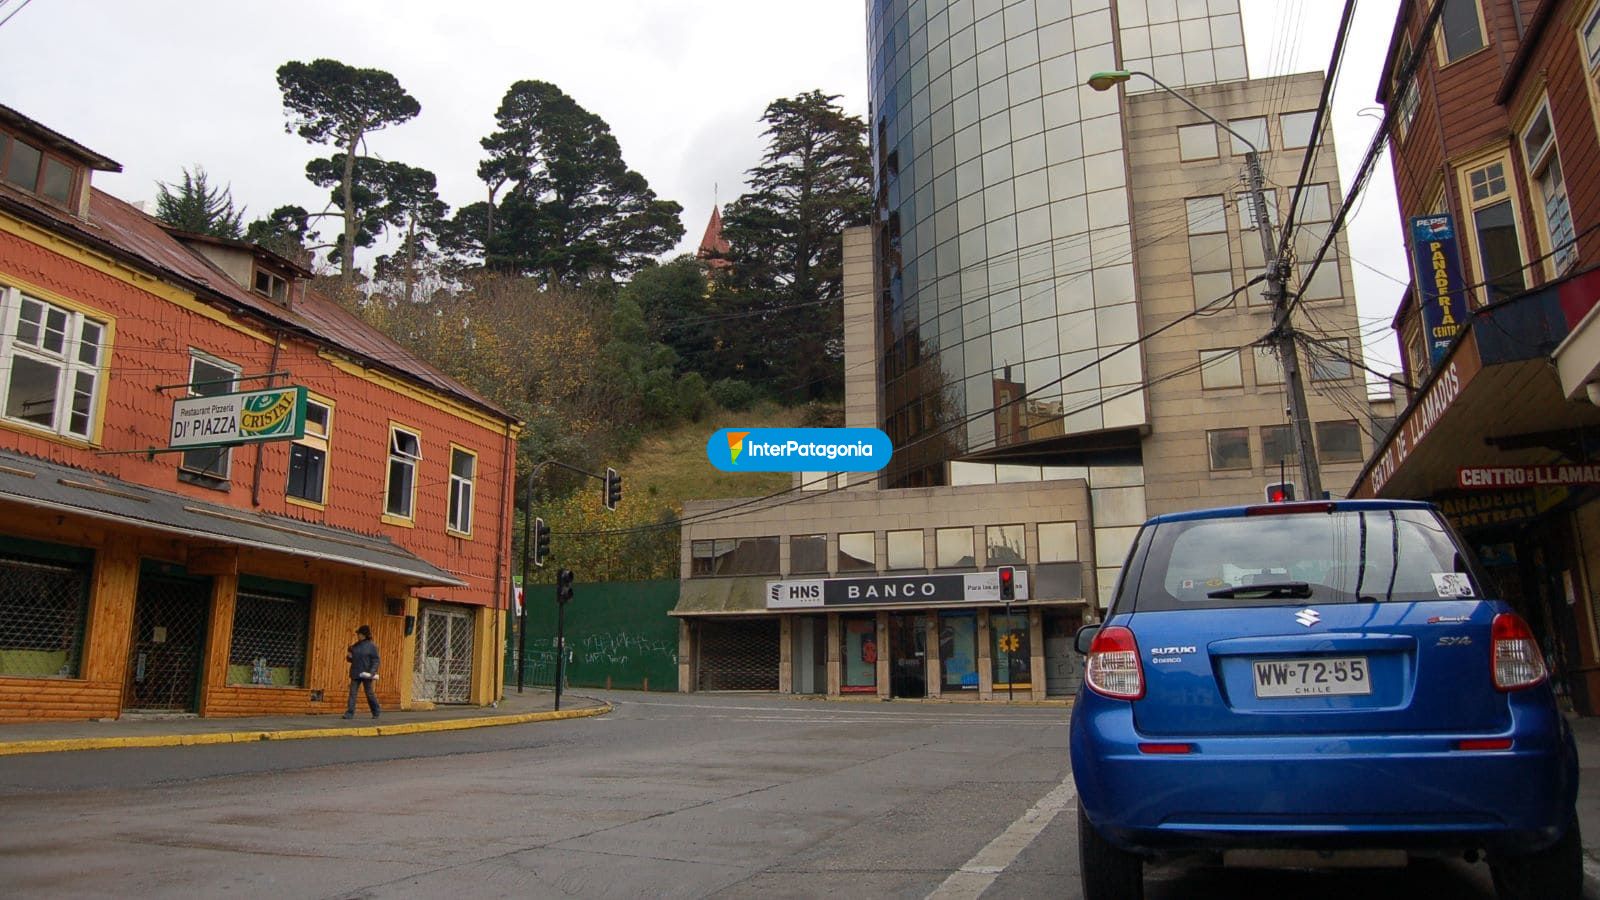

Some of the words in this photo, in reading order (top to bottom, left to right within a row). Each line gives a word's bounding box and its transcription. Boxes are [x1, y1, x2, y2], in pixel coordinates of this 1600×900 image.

[1416, 217, 1448, 227] PEPSI
[1430, 242, 1454, 325] PANADERIA
[180, 406, 210, 417] Restaurant
[211, 403, 234, 414] Pizzeria
[241, 391, 294, 428] CRISTAL
[193, 416, 236, 437] PIAZZA
[1371, 448, 1394, 494] CENTRO
[1396, 429, 1407, 463] DE
[1409, 361, 1460, 446] LLAMADOS
[1461, 468, 1525, 486] CENTRO
[790, 585, 820, 600] HNS
[848, 582, 937, 599] BANCO
[1151, 646, 1197, 655] SUZUKI
[1295, 686, 1332, 694] CHILE
